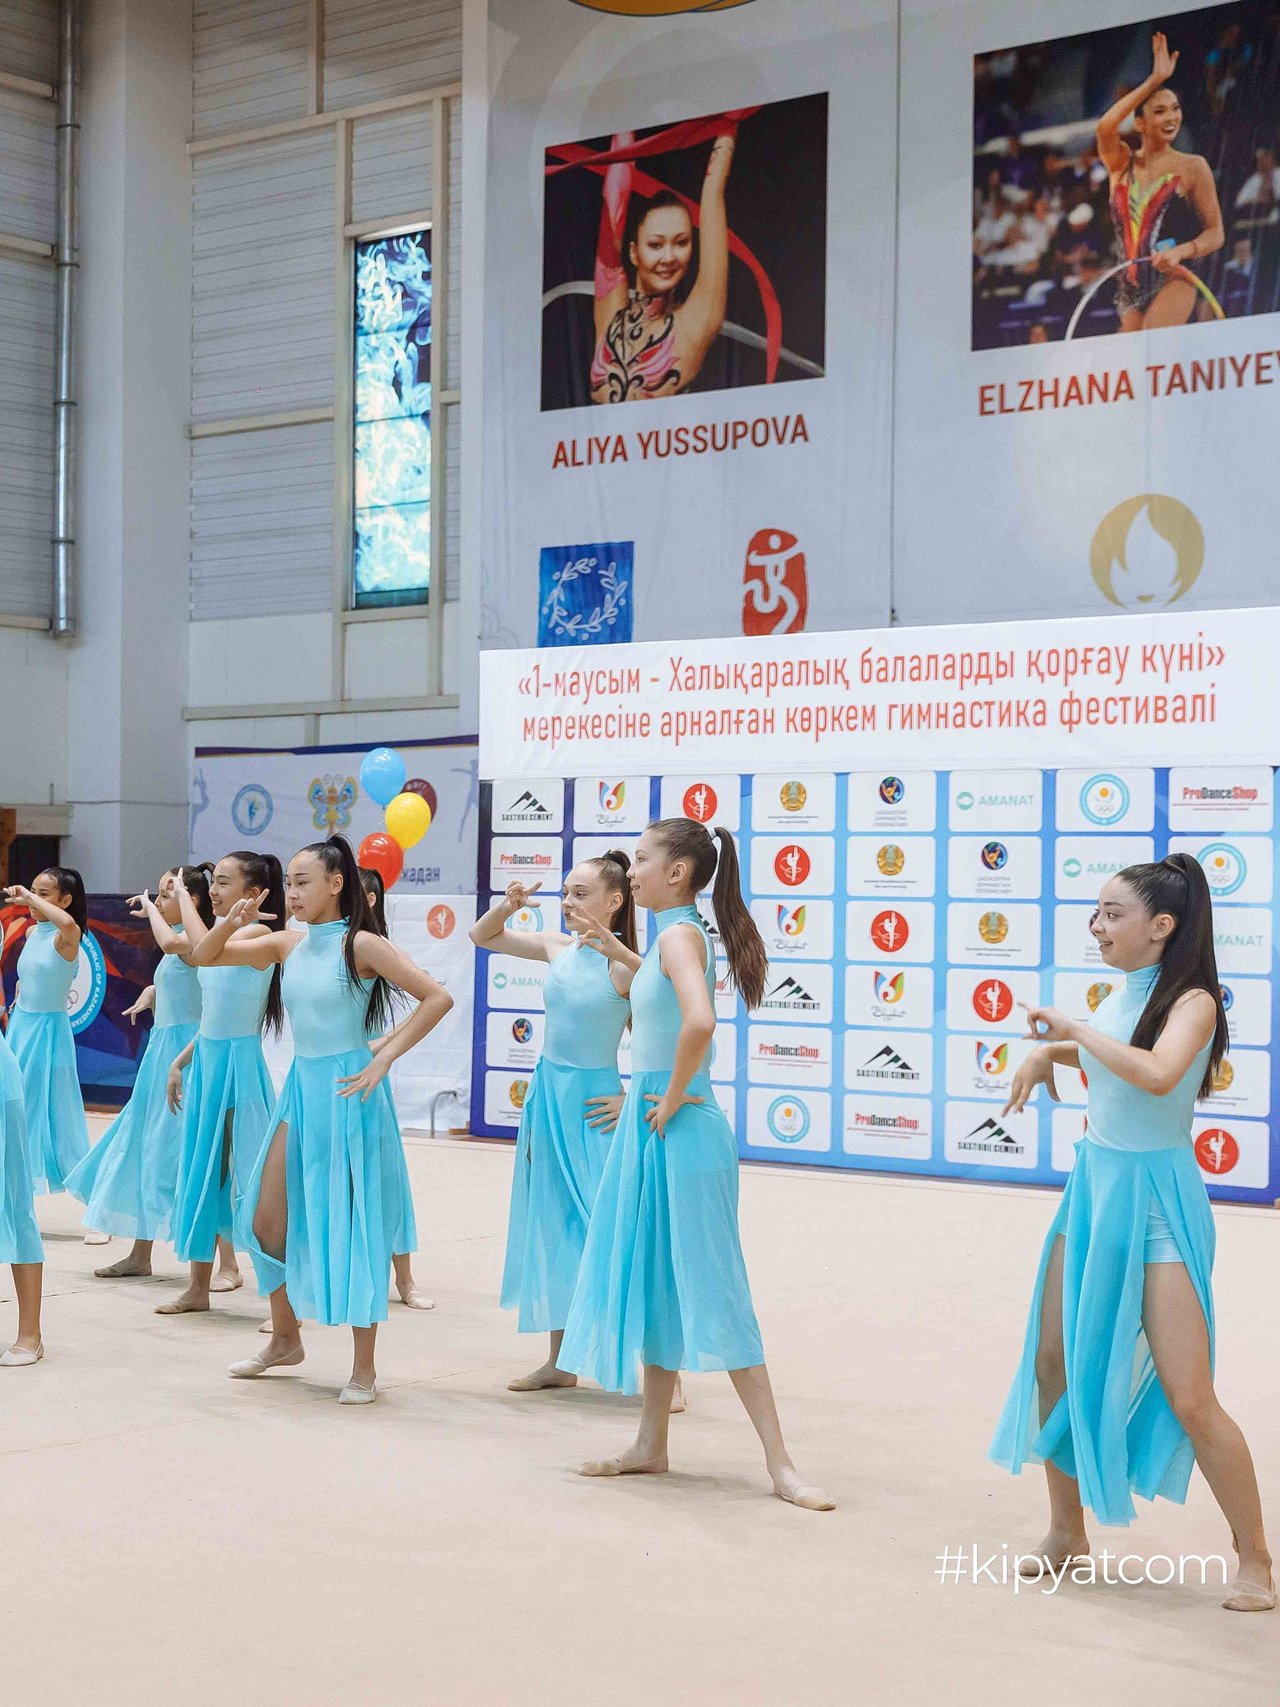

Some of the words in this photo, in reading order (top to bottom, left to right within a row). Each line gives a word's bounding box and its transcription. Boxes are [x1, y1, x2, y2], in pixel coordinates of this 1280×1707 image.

[979, 369, 1134, 417] ELZHANA
[1146, 350, 1280, 397] TANIYE
[552, 434, 628, 469] ALIYA
[637, 414, 809, 460] YUSSUPOVA
[518, 663, 641, 705] «1-маусым
[669, 655, 850, 697] Халықаралық
[860, 646, 1014, 690] балаларды
[1027, 645, 1129, 687] қорғау
[1141, 631, 1225, 684] күні»
[523, 704, 651, 749] мерекесіне
[660, 706, 775, 746] арналған
[786, 700, 876, 743] көркем
[888, 695, 1047, 730] гимнастика
[1060, 682, 1217, 733] фестивалі
[978, 794, 1035, 806] AMANAT
